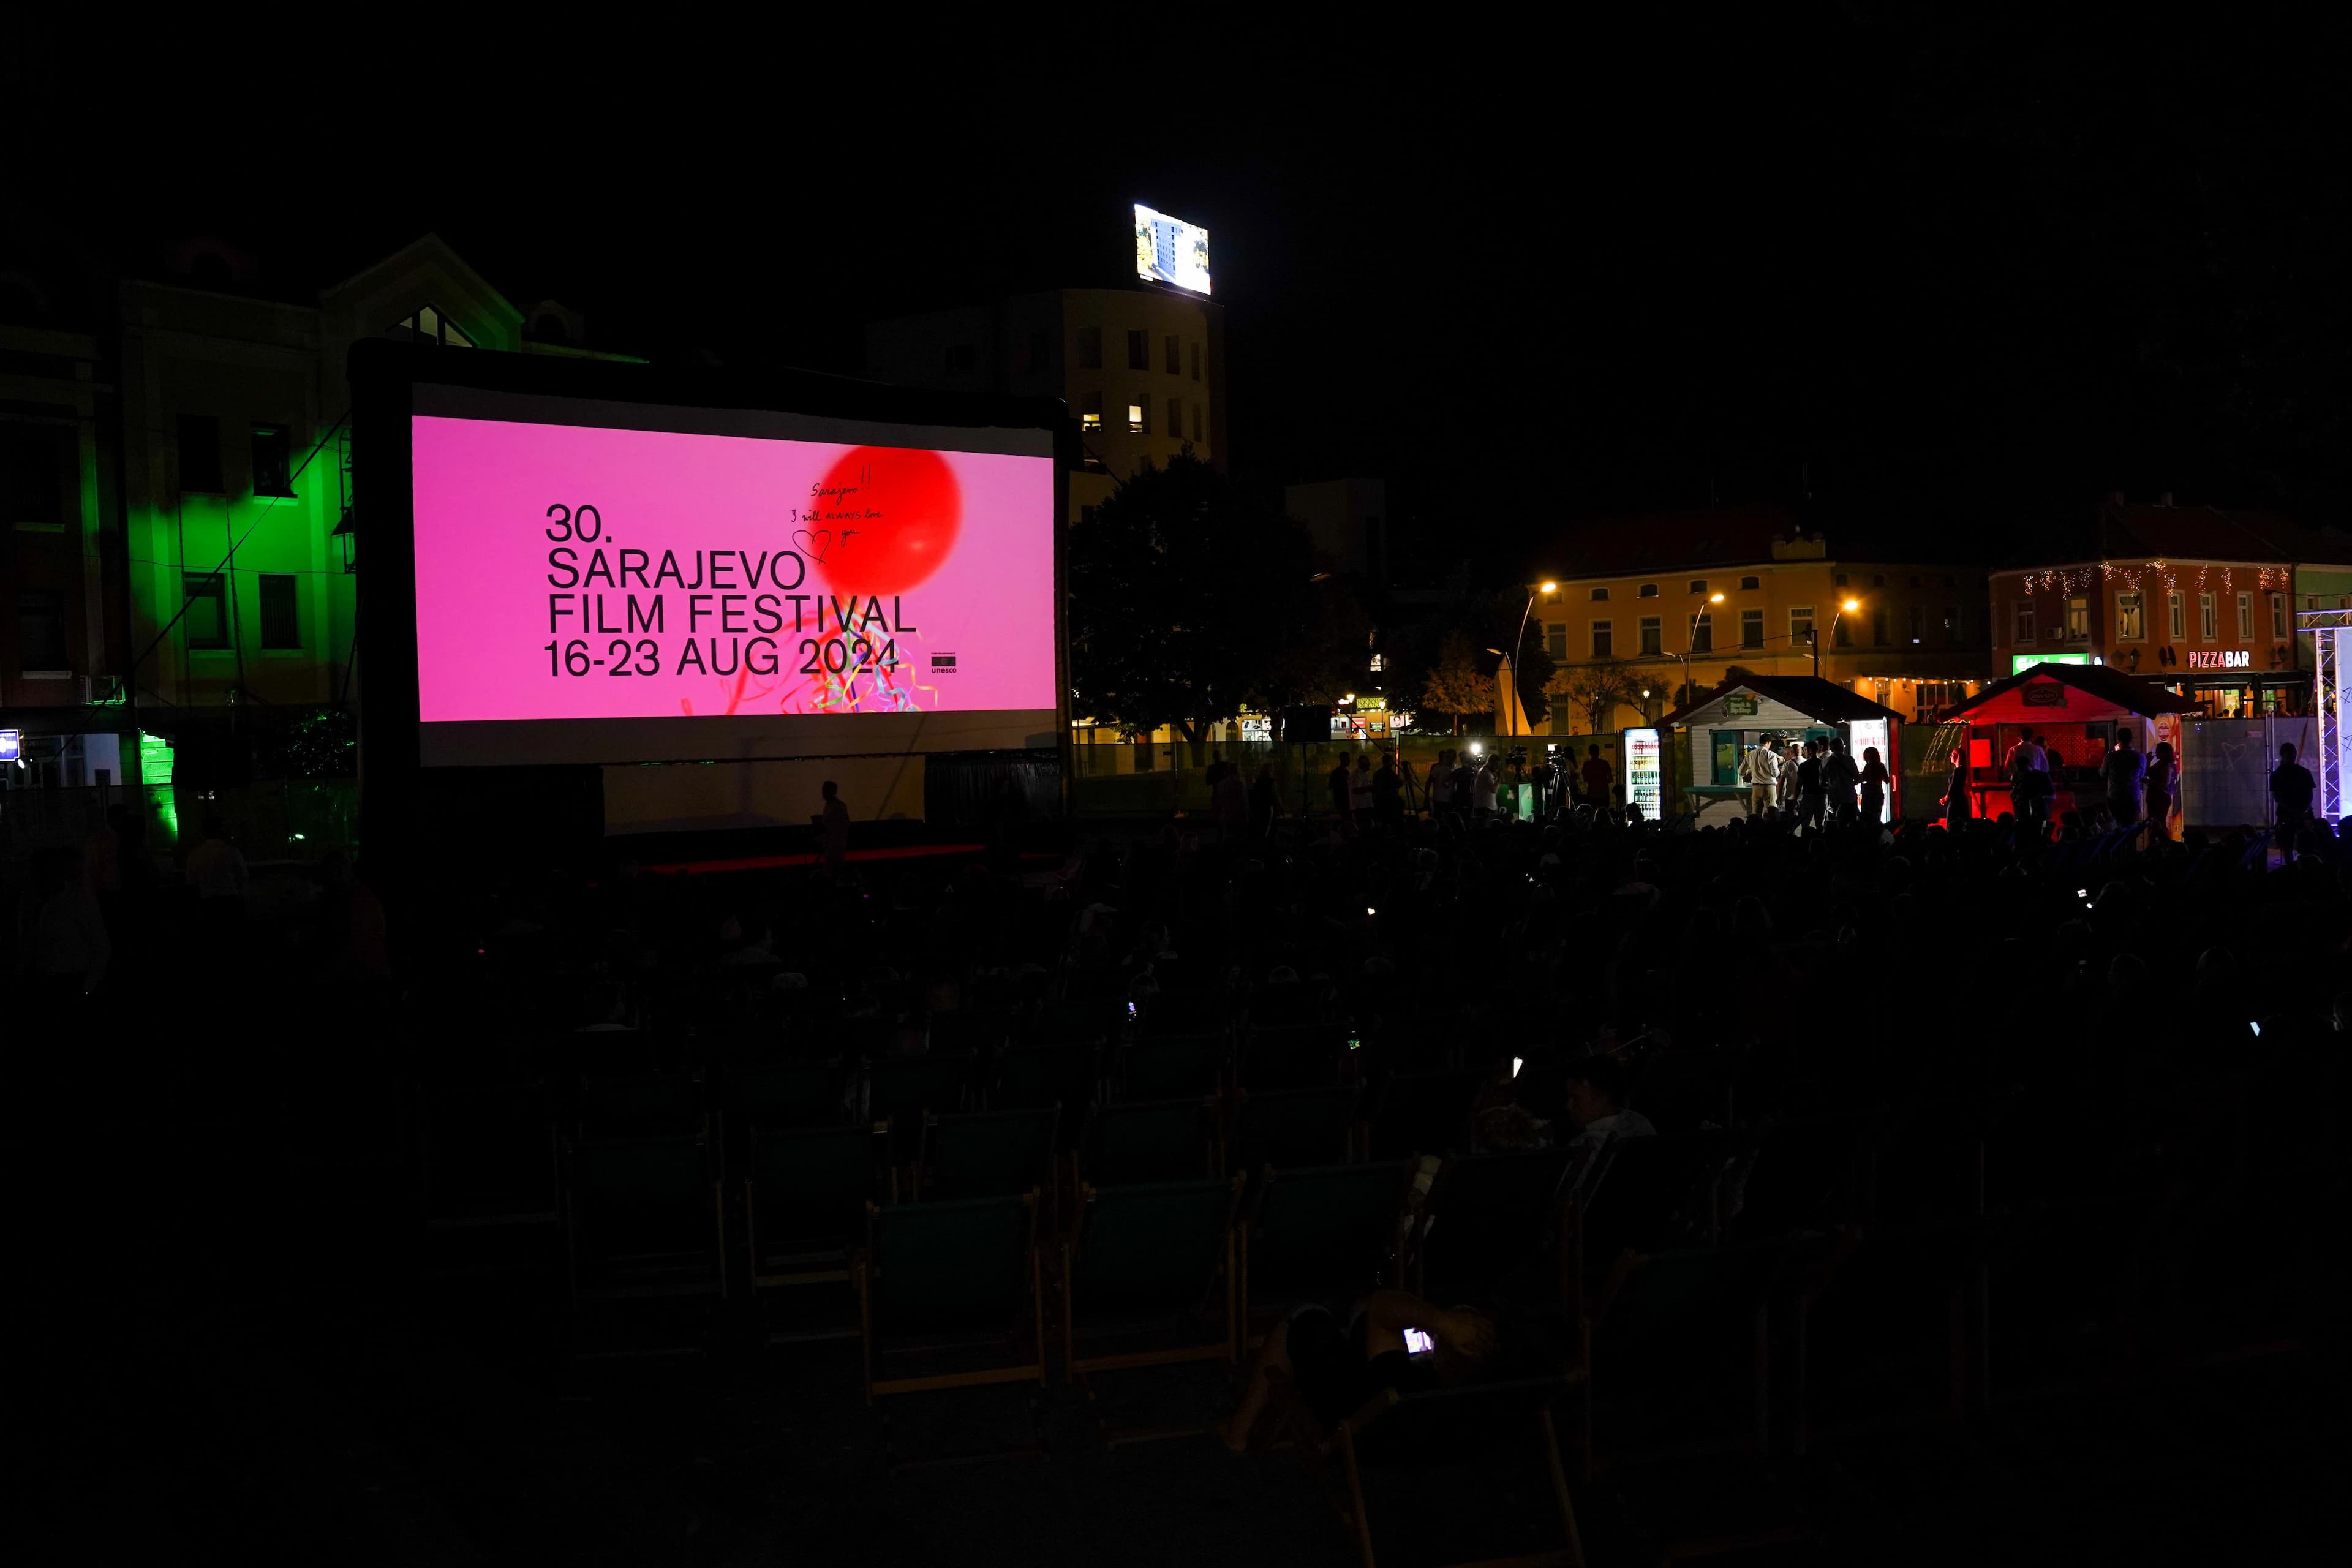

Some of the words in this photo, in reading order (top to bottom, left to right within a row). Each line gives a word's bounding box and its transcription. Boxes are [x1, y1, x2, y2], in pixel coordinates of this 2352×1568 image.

[546, 503, 612, 543] 30.
[791, 509, 797, 523] I
[802, 510, 822, 522] will
[826, 511, 861, 521] ALWAYS
[864, 509, 884, 518] love
[841, 529, 861, 547] you
[548, 547, 805, 590] SARAJEVO
[549, 594, 663, 633] FILM
[690, 594, 916, 633] FESTIVAL
[544, 639, 660, 677] 16-23
[677, 636, 778, 676] AUG
[799, 637, 900, 674] 2024
